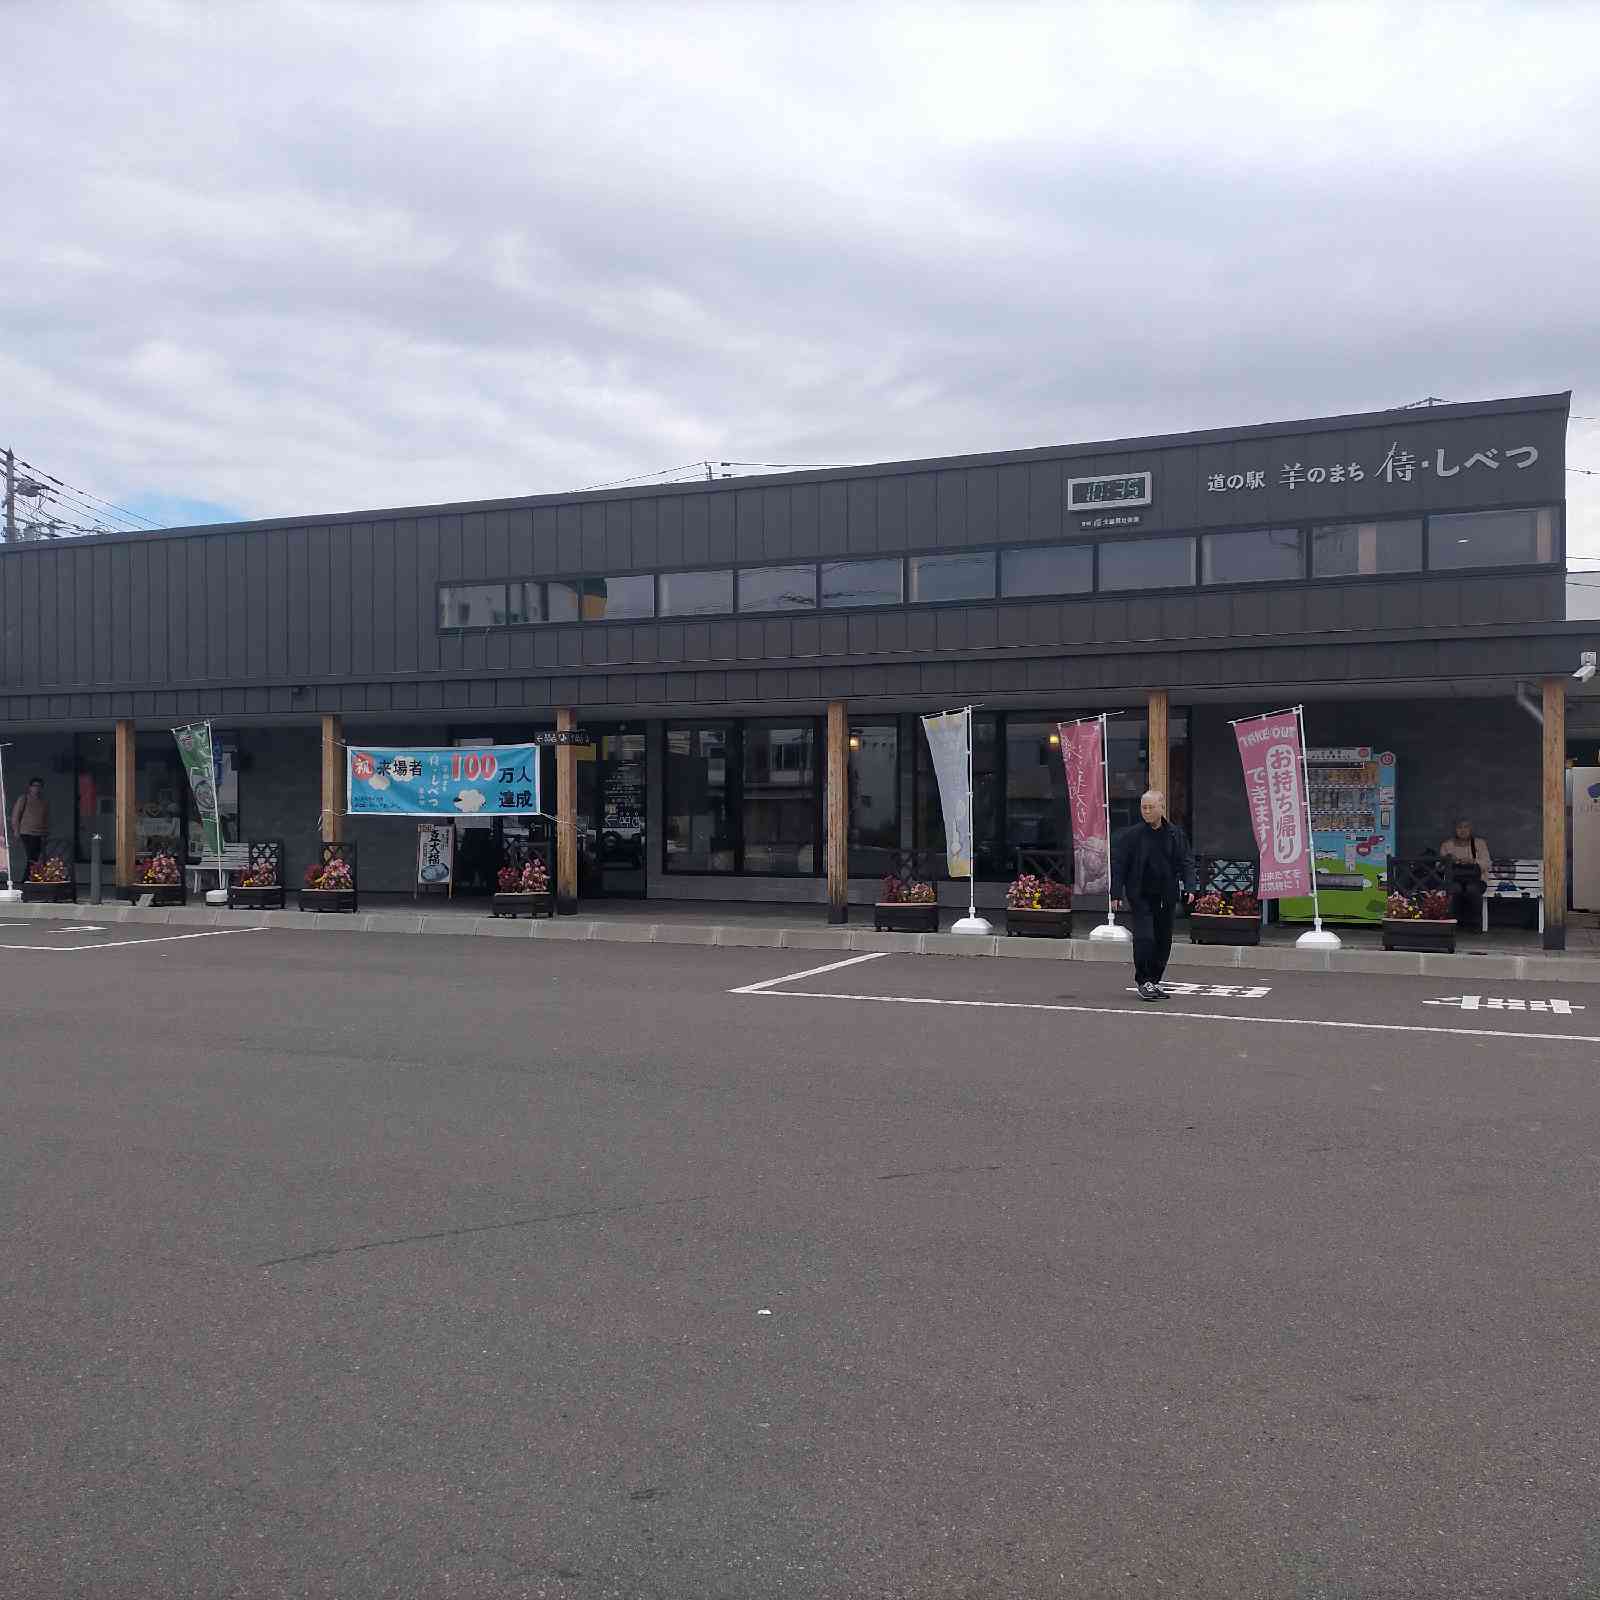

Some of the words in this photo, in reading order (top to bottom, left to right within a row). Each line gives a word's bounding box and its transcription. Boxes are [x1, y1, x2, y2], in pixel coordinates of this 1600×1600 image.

[1207, 470, 1266, 492] 道の駅
[1279, 462, 1365, 490] 羊のまち
[353, 757, 373, 778] 祝
[376, 759, 423, 777] 来場者
[496, 789, 533, 809] 達成
[1270, 748, 1297, 860] お持ち帰り
